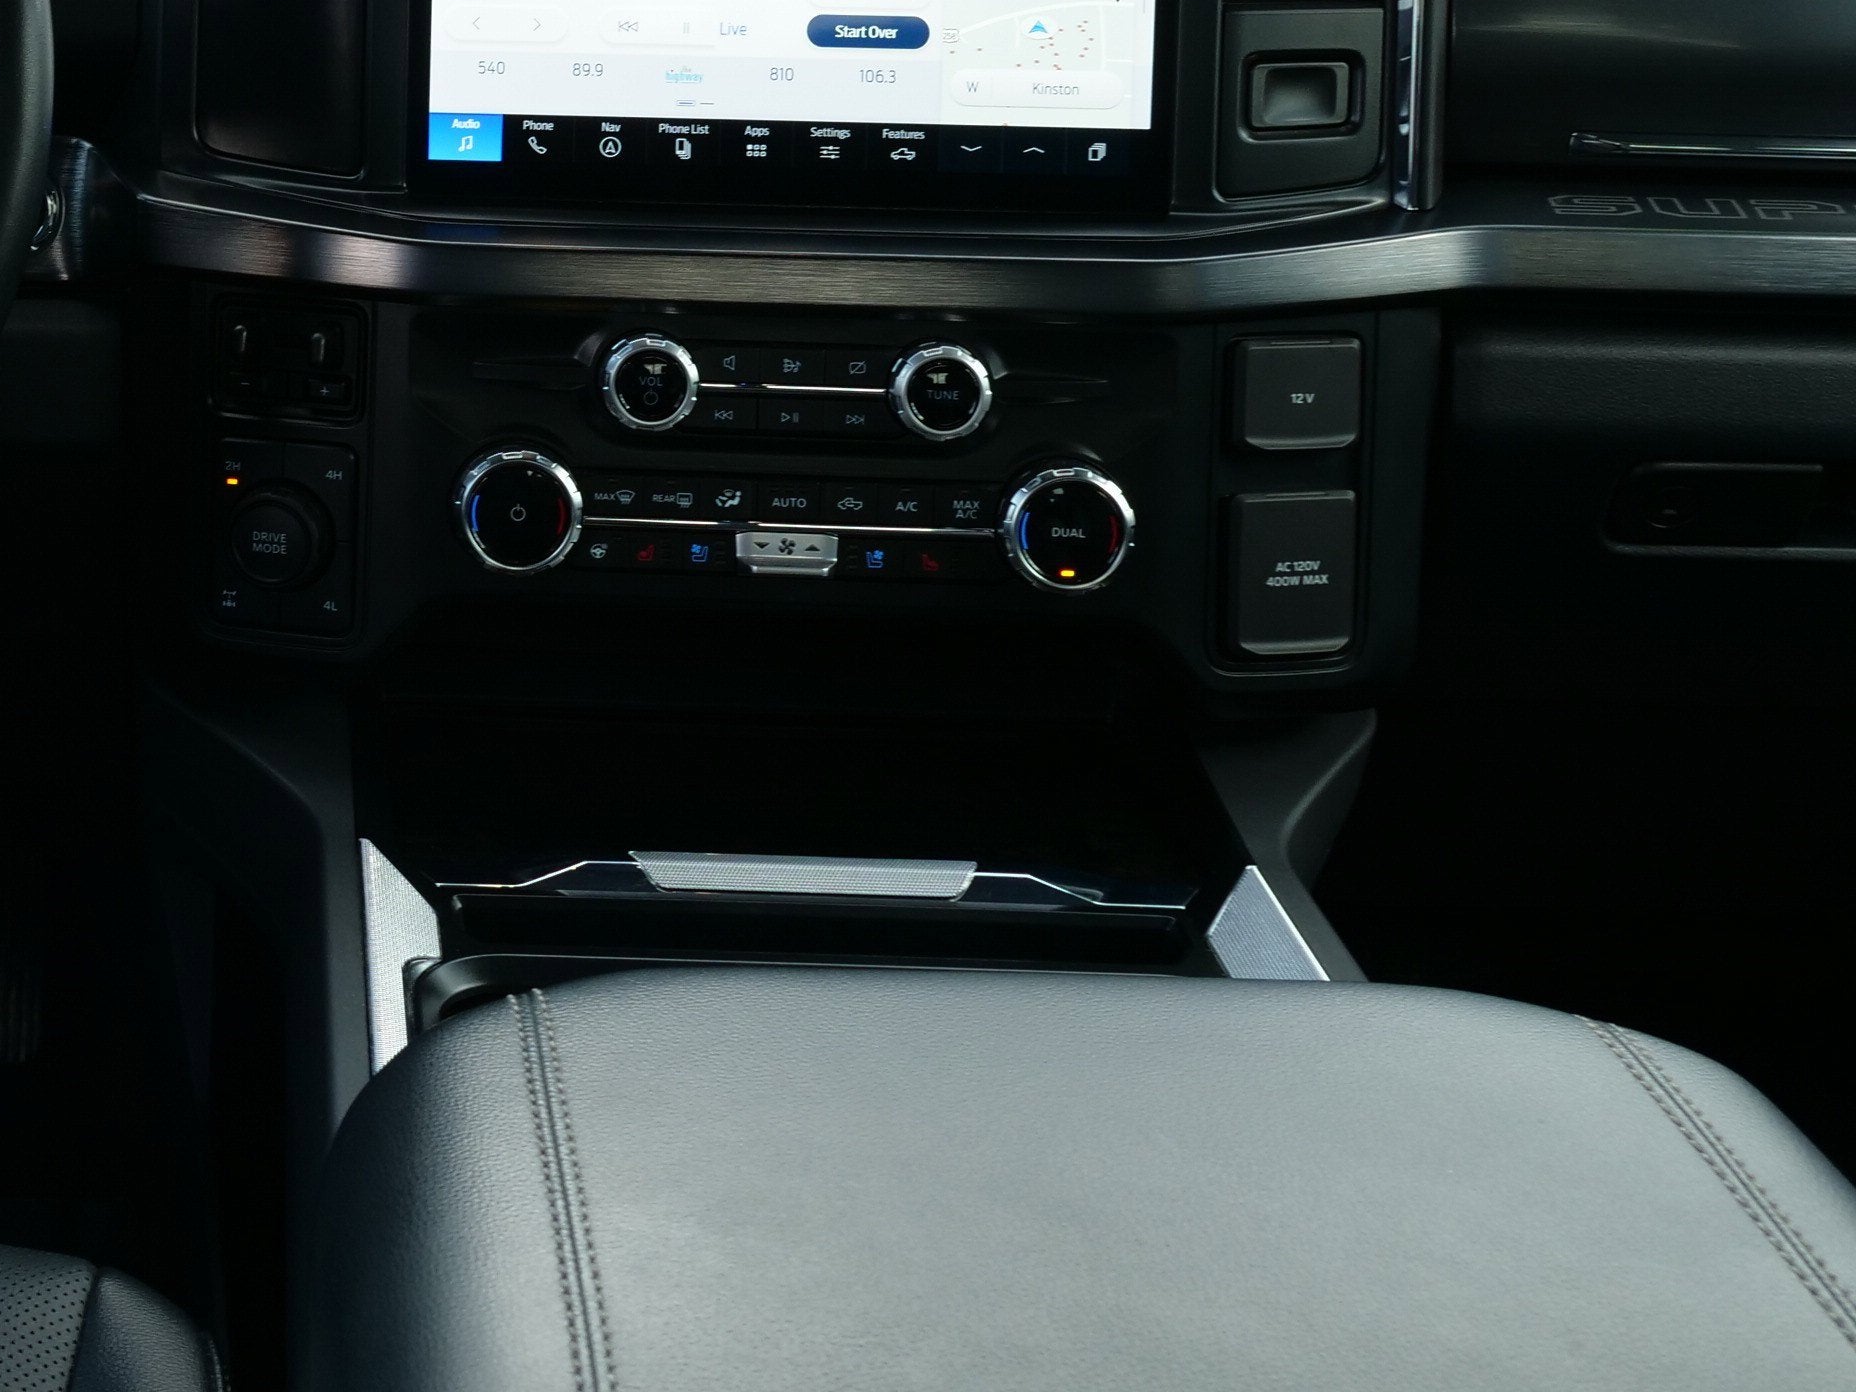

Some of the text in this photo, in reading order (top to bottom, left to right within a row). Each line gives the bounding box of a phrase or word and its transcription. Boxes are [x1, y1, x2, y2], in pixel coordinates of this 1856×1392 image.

[720, 22, 748, 37] Live
[835, 25, 898, 39] Start Over
[478, 61, 506, 75] 540
[572, 62, 604, 78] 89.9
[769, 67, 794, 82] 810
[859, 69, 897, 84] 106.3
[966, 81, 979, 93] W
[1032, 82, 1080, 96] Kinston
[452, 118, 481, 130] Audio
[522, 119, 554, 131] Phone
[601, 121, 621, 133] Nav
[658, 122, 710, 135] Phone List
[744, 125, 770, 138] Apps
[810, 126, 851, 140] Settings
[882, 128, 926, 140] Features
[1547, 194, 1856, 221] SUP
[637, 376, 663, 387] VOL
[926, 389, 960, 401] TUNE
[224, 460, 241, 471] 2H
[325, 469, 343, 481] 4H
[594, 492, 615, 502] MAX
[652, 493, 676, 503] REAR
[772, 496, 807, 508] AUTO
[895, 500, 919, 513] A/C
[952, 499, 980, 510] MAX
[955, 508, 978, 519] A/C
[252, 531, 287, 543] DRIVE
[1051, 527, 1086, 539] DUAL
[252, 543, 287, 554] MODE
[1275, 560, 1321, 572] AC 120V
[1265, 574, 1329, 587] 400W MAX
[322, 600, 338, 612] 4L
